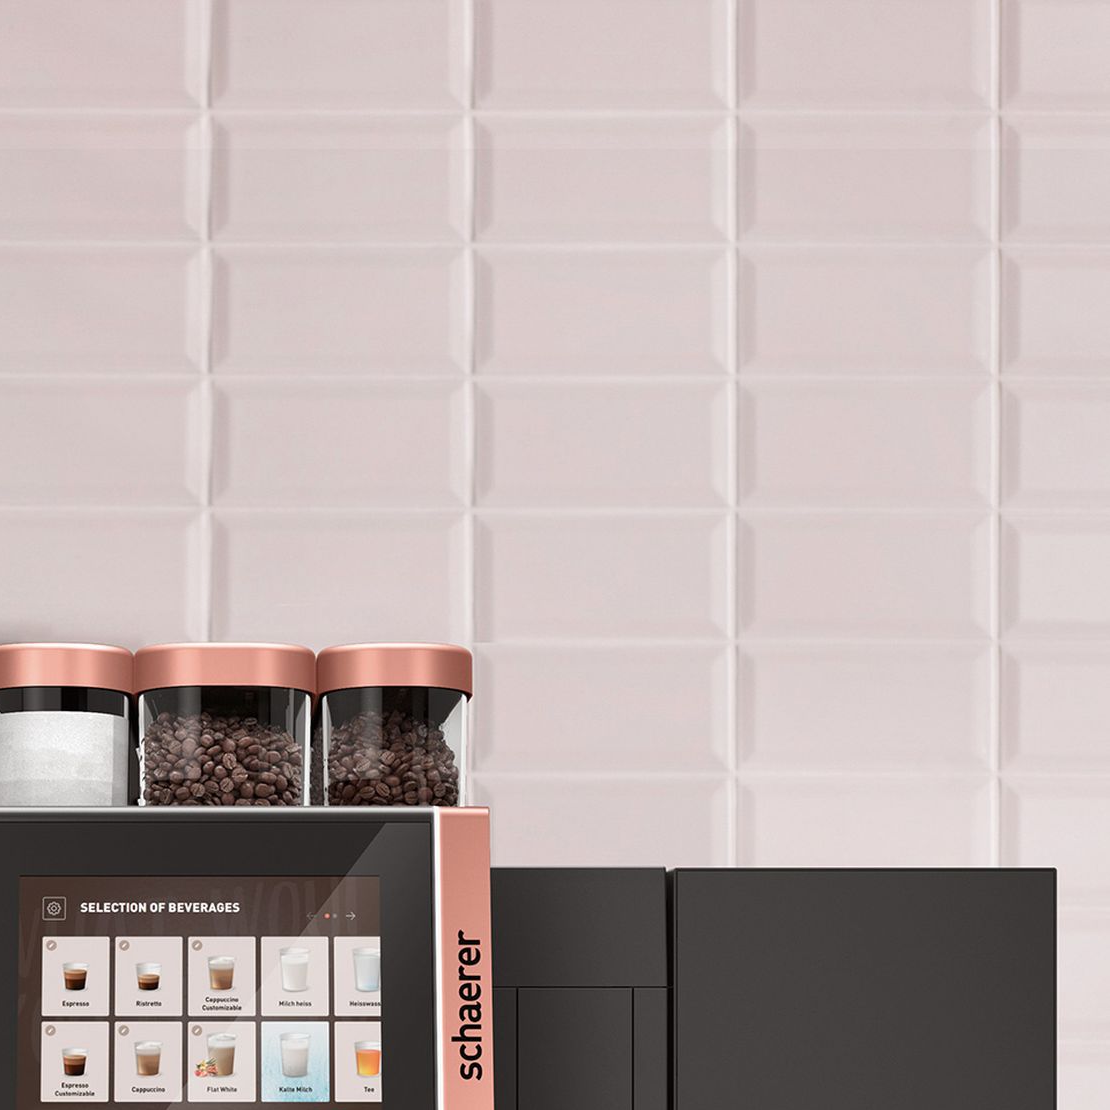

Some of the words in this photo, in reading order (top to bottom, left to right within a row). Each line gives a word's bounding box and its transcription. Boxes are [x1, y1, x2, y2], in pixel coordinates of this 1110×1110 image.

[80, 902, 147, 913] SELECTION
[149, 902, 166, 913] OF
[168, 902, 240, 913] BEVERAGES
[61, 1000, 90, 1008] Espresso
[205, 996, 239, 1004] Cappuccino
[451, 929, 483, 1081] schaerer
[61, 1082, 89, 1090] Espresso
[131, 1086, 166, 1094] Cappuccino
